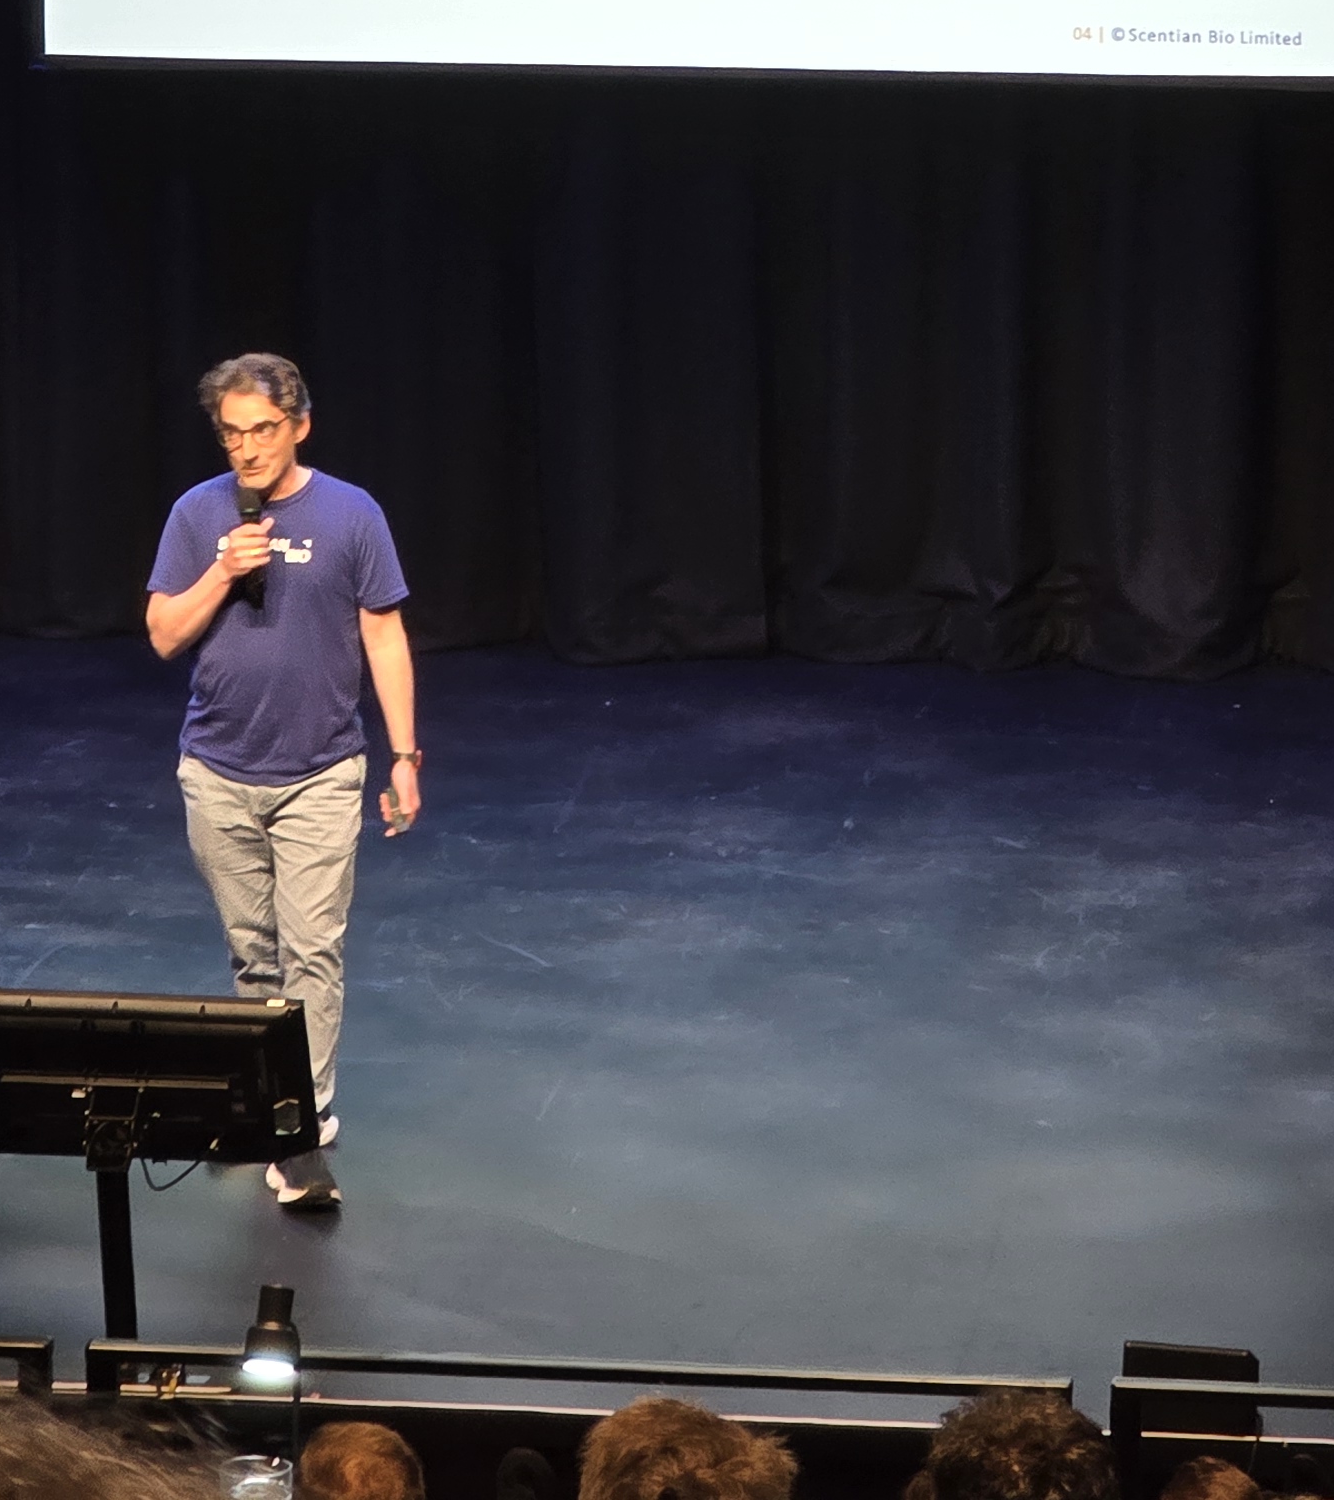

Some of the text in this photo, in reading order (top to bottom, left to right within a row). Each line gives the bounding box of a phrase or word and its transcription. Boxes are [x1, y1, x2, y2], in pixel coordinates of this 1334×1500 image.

[1072, 26, 1092, 40] 04
[1208, 30, 1235, 44] Bio
[1240, 31, 1303, 46] Limited
